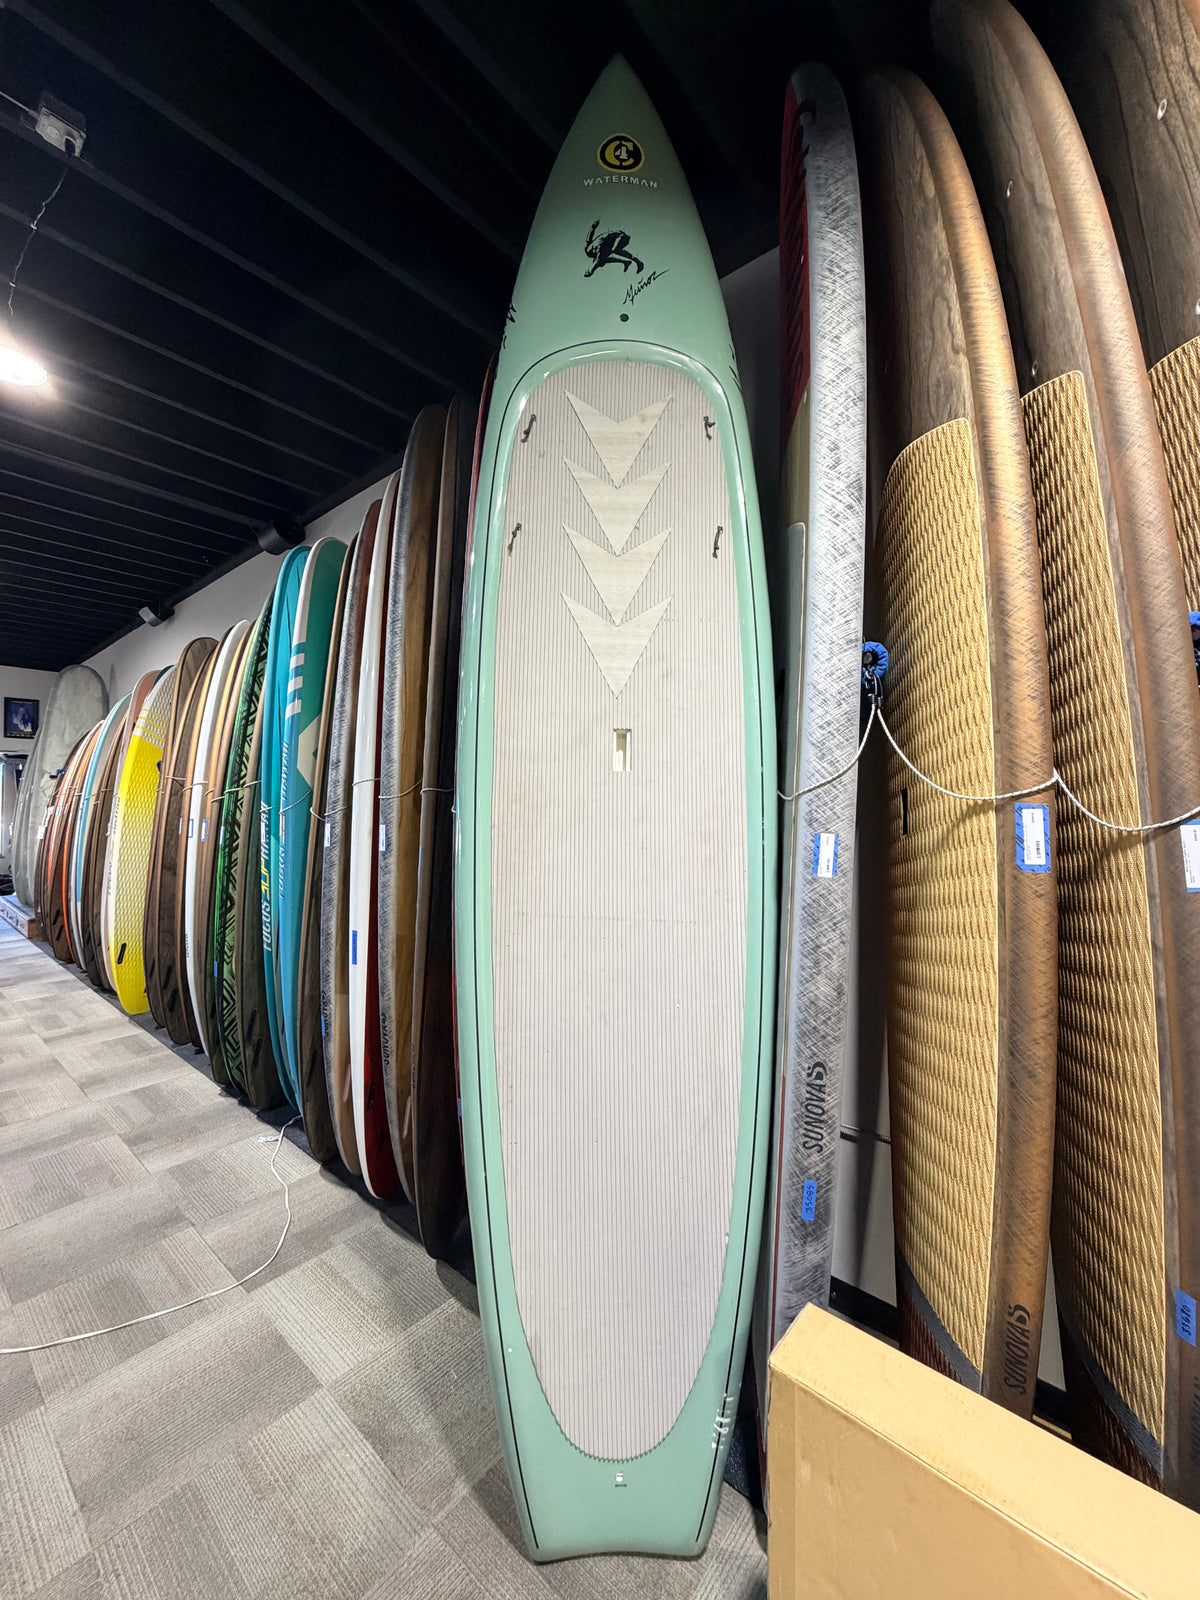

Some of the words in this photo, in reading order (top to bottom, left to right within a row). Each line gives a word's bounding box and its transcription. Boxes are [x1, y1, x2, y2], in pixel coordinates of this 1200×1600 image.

[583, 175, 658, 188] WATERMAN
[261, 900, 272, 952] FOCUS
[803, 1083, 826, 1153] SUNOVA
[1004, 1321, 1031, 1395] SUNOVA
